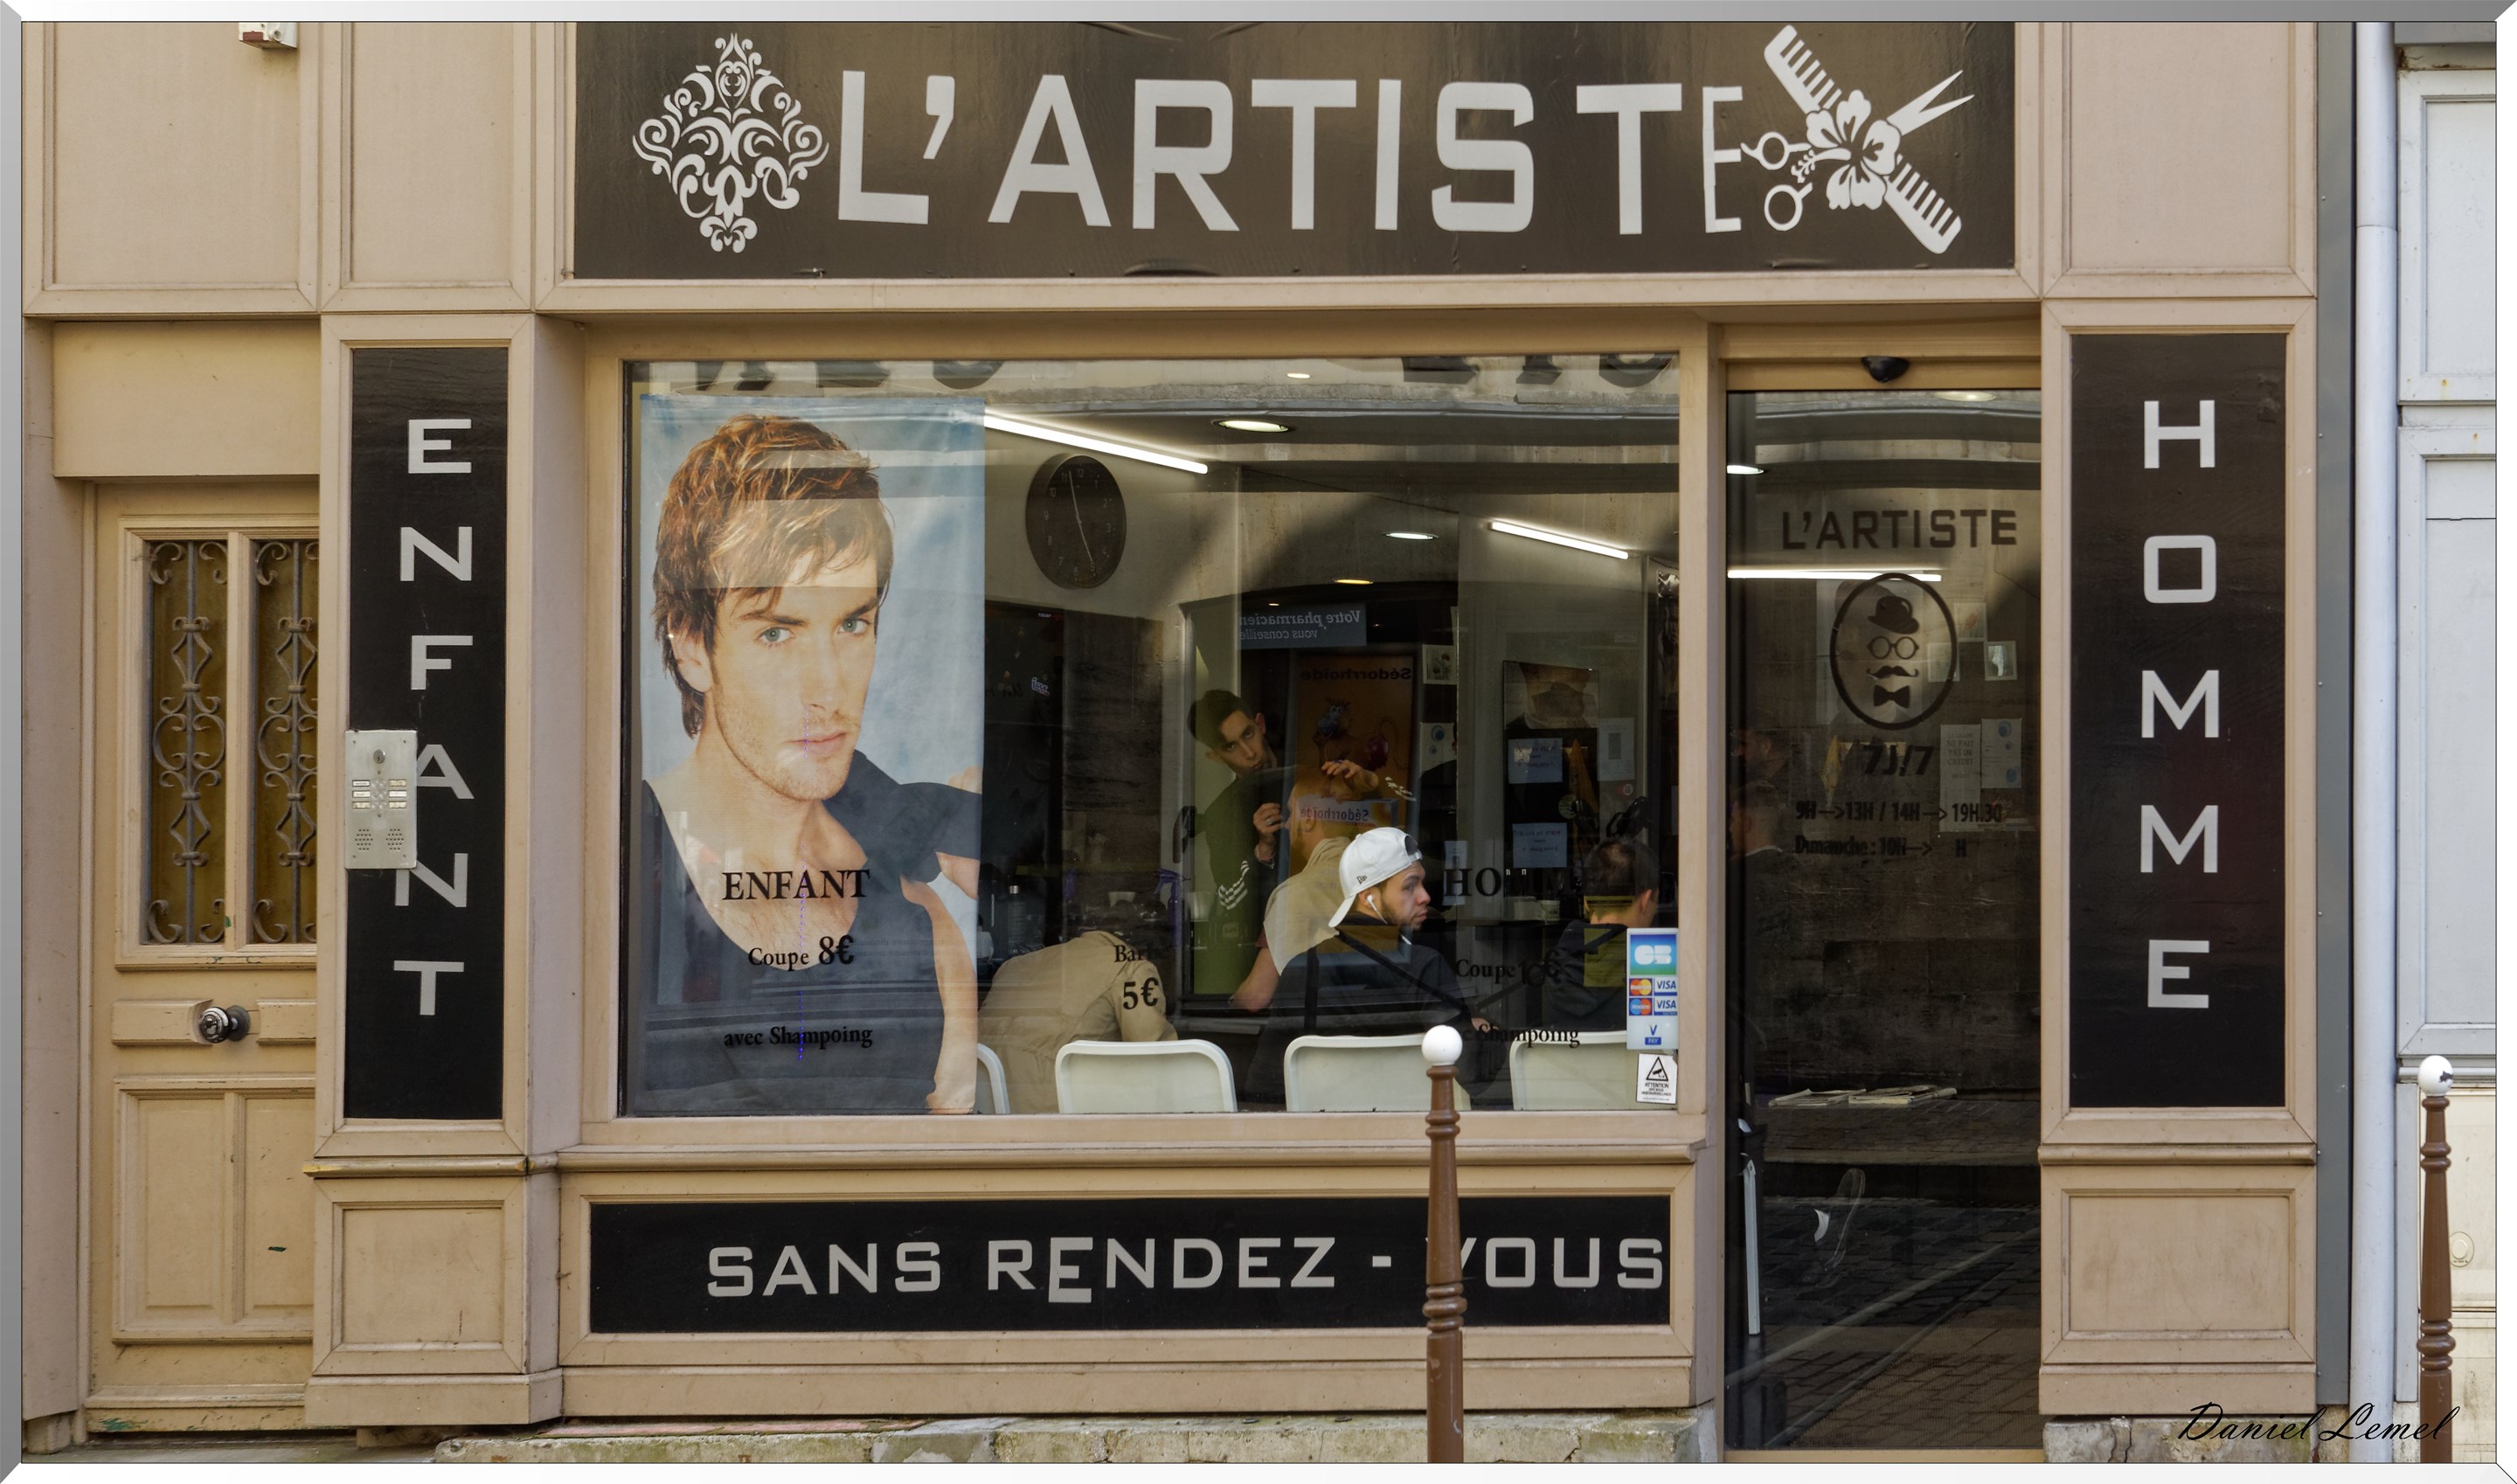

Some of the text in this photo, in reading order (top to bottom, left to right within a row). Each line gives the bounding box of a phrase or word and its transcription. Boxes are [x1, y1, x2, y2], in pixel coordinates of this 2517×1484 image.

[394, 418, 475, 1016] ENFANT
[2139, 399, 2221, 1009] HOMME
[722, 868, 871, 901] ENFANT
[748, 947, 810, 972] Coupe
[818, 934, 855, 966] 8€
[1455, 958, 1516, 985] Coupe
[1656, 980, 1677, 989] VISA
[1122, 976, 1160, 1010] 5€
[1656, 1000, 1677, 1009] VISA
[724, 1025, 873, 1049] avec Shampoing
[706, 1243, 941, 1298] SANS
[988, 1235, 1337, 1305] RENDEZ
